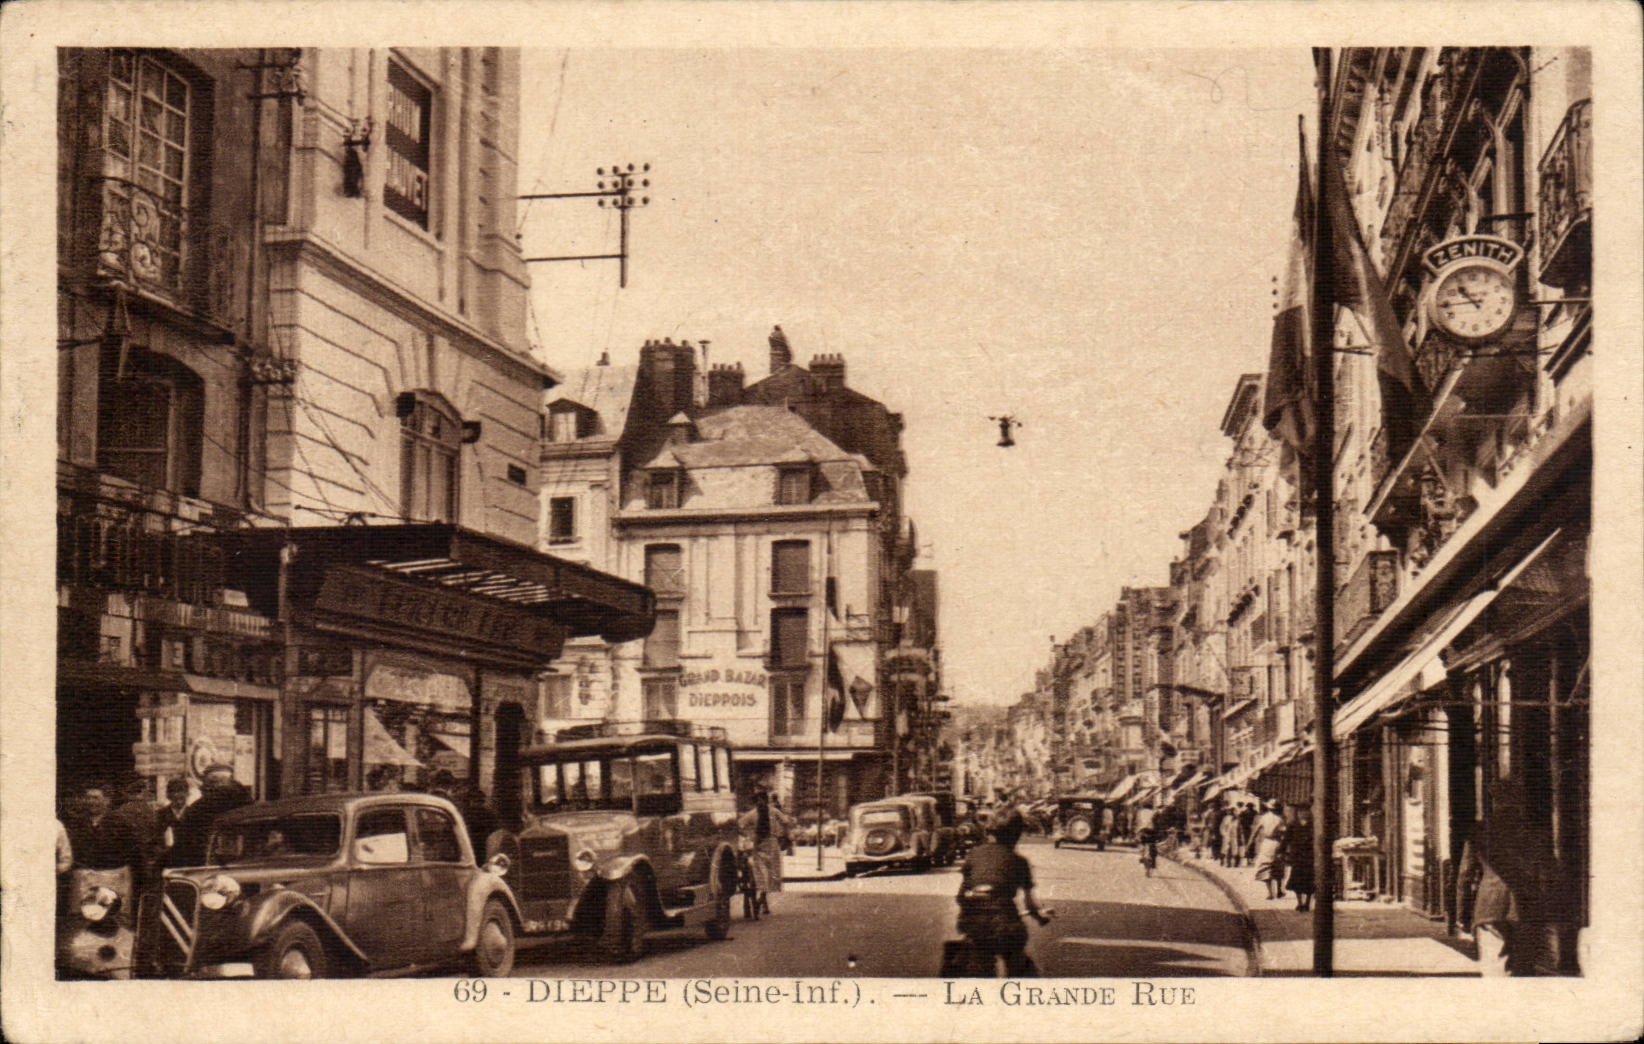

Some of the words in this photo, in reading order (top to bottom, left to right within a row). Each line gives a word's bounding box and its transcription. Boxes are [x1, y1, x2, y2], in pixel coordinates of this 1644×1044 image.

[1433, 241, 1513, 265] ZENITH
[679, 669, 720, 688] GRAND
[725, 668, 767, 689] BAZAR
